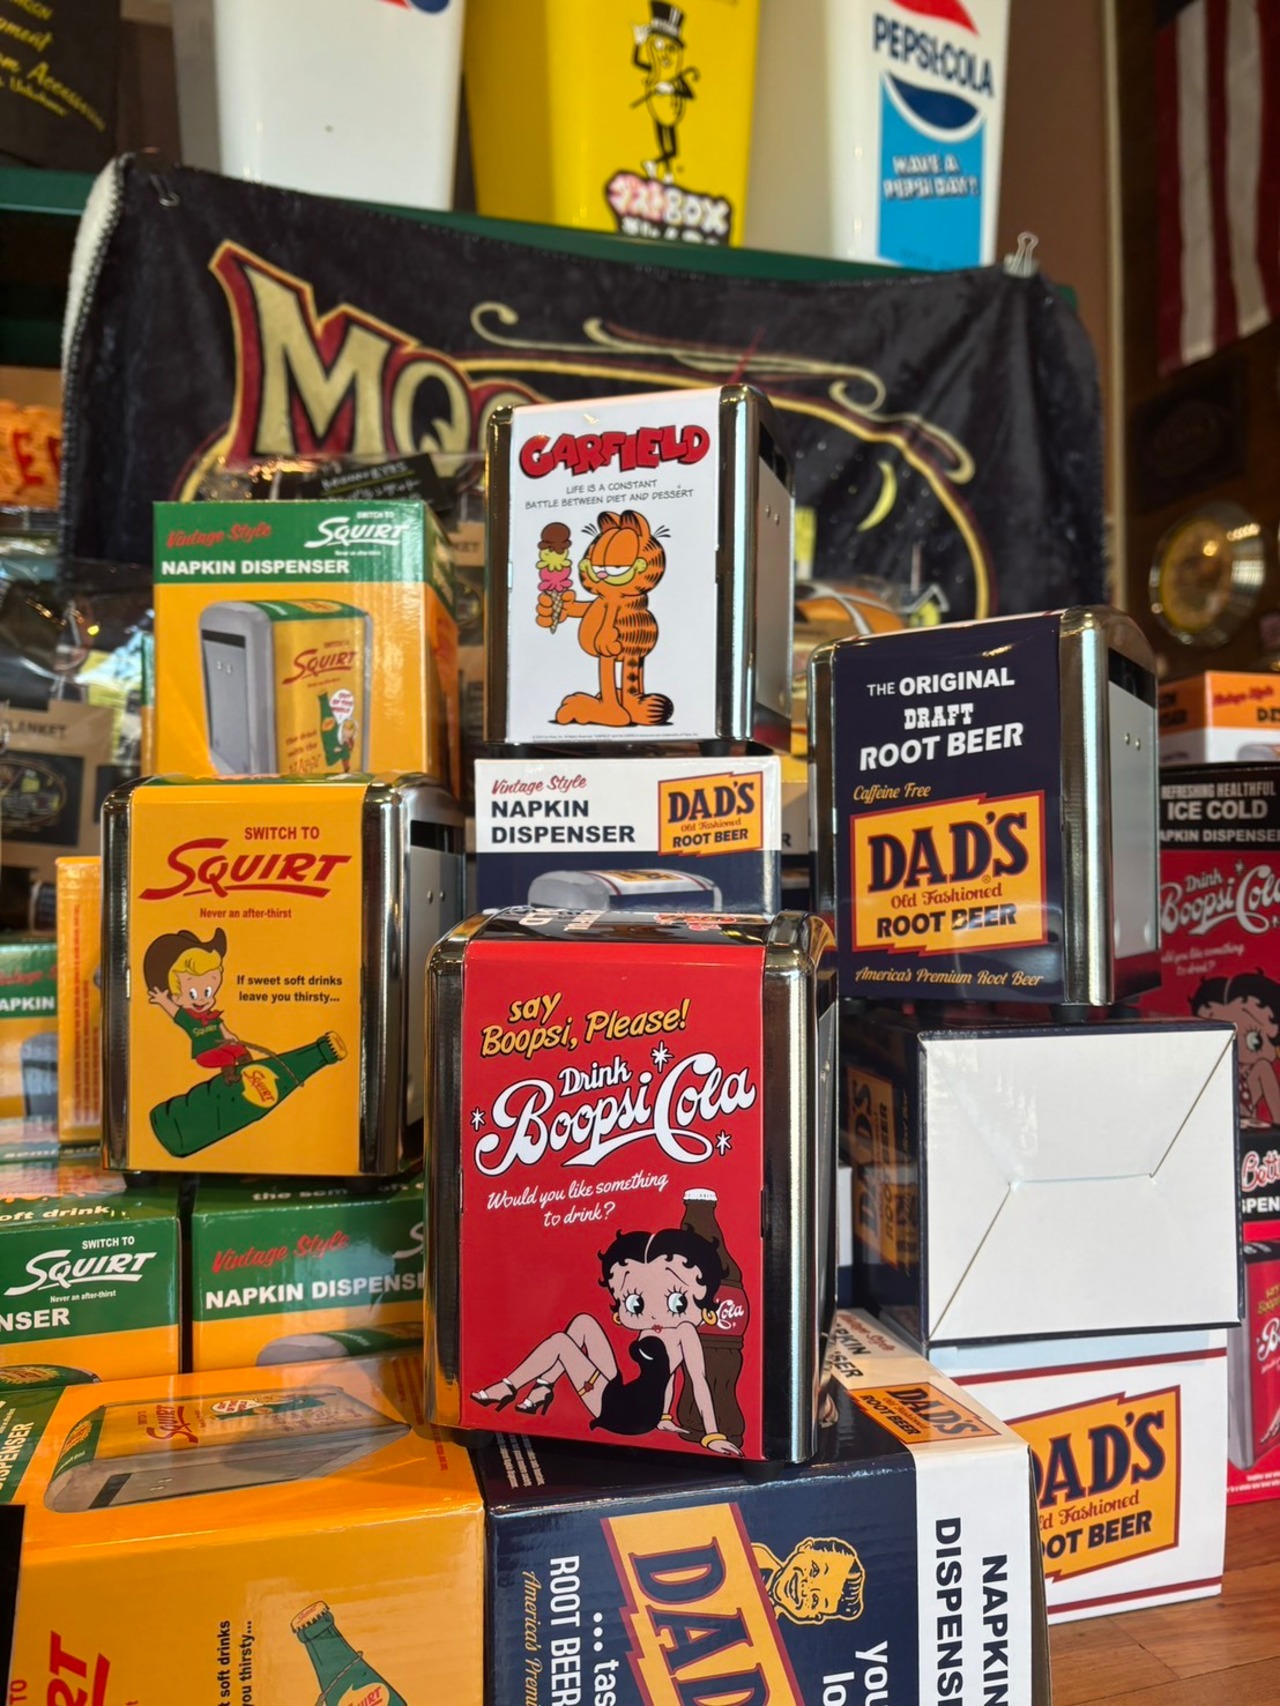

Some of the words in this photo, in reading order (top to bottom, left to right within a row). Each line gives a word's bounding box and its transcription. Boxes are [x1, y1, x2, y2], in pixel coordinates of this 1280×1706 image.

[519, 425, 710, 479] GARFIELD
[525, 500, 559, 510] BATTLE
[561, 496, 603, 507] BETWEEN
[606, 495, 626, 504] DIET
[629, 493, 649, 502] AND
[652, 489, 693, 499] DESSERT
[566, 486, 584, 494] LIFE
[587, 485, 595, 493] IS
[599, 484, 605, 492] A
[608, 480, 657, 491] CONSTANT
[167, 529, 224, 548] Vintage
[228, 522, 271, 543] Style
[303, 516, 410, 548] SQUIRT
[161, 560, 236, 575] NAPKIN
[241, 559, 350, 575] DISPENSER
[282, 649, 357, 685] SQUIRT
[867, 682, 895, 697] THE
[899, 667, 1015, 696] ORIGINAL
[904, 703, 974, 730] DRAFT
[859, 735, 940, 771] ROOT
[947, 722, 1024, 757] BEER
[491, 779, 544, 795] Vintage
[547, 774, 588, 793] Style
[853, 785, 900, 804] Caffeine
[904, 782, 931, 798] Free
[491, 800, 589, 818] NAPKIN
[668, 781, 755, 824] DAD'S
[1167, 801, 1202, 820] ICE
[1206, 800, 1268, 820] COLD
[244, 826, 298, 841] SWITCH
[300, 826, 320, 840] TO
[491, 825, 635, 843] DISPENSER
[673, 834, 711, 848] ROOT
[714, 828, 748, 843] BEER
[681, 823, 697, 832] Old
[867, 811, 1029, 894] DAD'S
[138, 837, 352, 901] SQUIRT
[1185, 867, 1222, 892] Drink
[891, 895, 918, 910] Old
[923, 883, 1003, 906] Fashioned
[200, 907, 227, 919] Never
[229, 910, 240, 919] an
[242, 907, 292, 919] after-thirst
[877, 911, 945, 939] ROOT
[952, 903, 1017, 931] BEER
[236, 974, 246, 986] If
[247, 975, 281, 986] sweet
[283, 974, 306, 986] soft
[308, 974, 343, 986] drinks
[855, 966, 912, 982] America's
[916, 968, 973, 984] Premium
[977, 970, 1008, 985] Root
[1012, 971, 1044, 987] Beer
[238, 991, 269, 1003] leave
[271, 993, 292, 1005] you
[293, 990, 340, 1005] thirsty...
[508, 992, 562, 1024] say
[481, 1017, 578, 1059] Boopsi,
[585, 999, 691, 1044] Please!
[242, 1070, 275, 1102] SQUIRT
[558, 1056, 632, 1096] Drink
[474, 1071, 654, 1176] Boopsi
[653, 1052, 757, 1164] Cola
[487, 1189, 536, 1209] Would
[540, 1189, 565, 1209] you
[568, 1180, 593, 1198] like
[595, 1170, 669, 1195] something
[544, 1209, 561, 1228] to
[564, 1201, 616, 1226] drink?
[82, 1238, 119, 1250] SWITCH
[121, 1236, 135, 1246] TO
[211, 1246, 288, 1274] Vintage
[293, 1230, 350, 1258] Style
[3, 1249, 158, 1296] SQUIRT
[50, 1295, 70, 1304] Never
[81, 1290, 117, 1299] after-thirst
[206, 1283, 304, 1309] NAPKIN
[716, 1299, 744, 1330] Cola
[835, 1323, 872, 1356] PKIN
[834, 1350, 864, 1379] SER
[860, 1393, 892, 1416] ROOT
[886, 1411, 921, 1436] BEER
[886, 1388, 982, 1435] DAD'S
[1058, 1490, 1140, 1525] Fashioned
[1088, 1510, 1152, 1549] BEER
[550, 1556, 580, 1627] ROOT
[522, 1571, 542, 1652] America's
[217, 1620, 231, 1665] drinks
[239, 1620, 255, 1682] thirsty...
[9, 1679, 28, 1706] TO
[217, 1669, 231, 1704] soft
